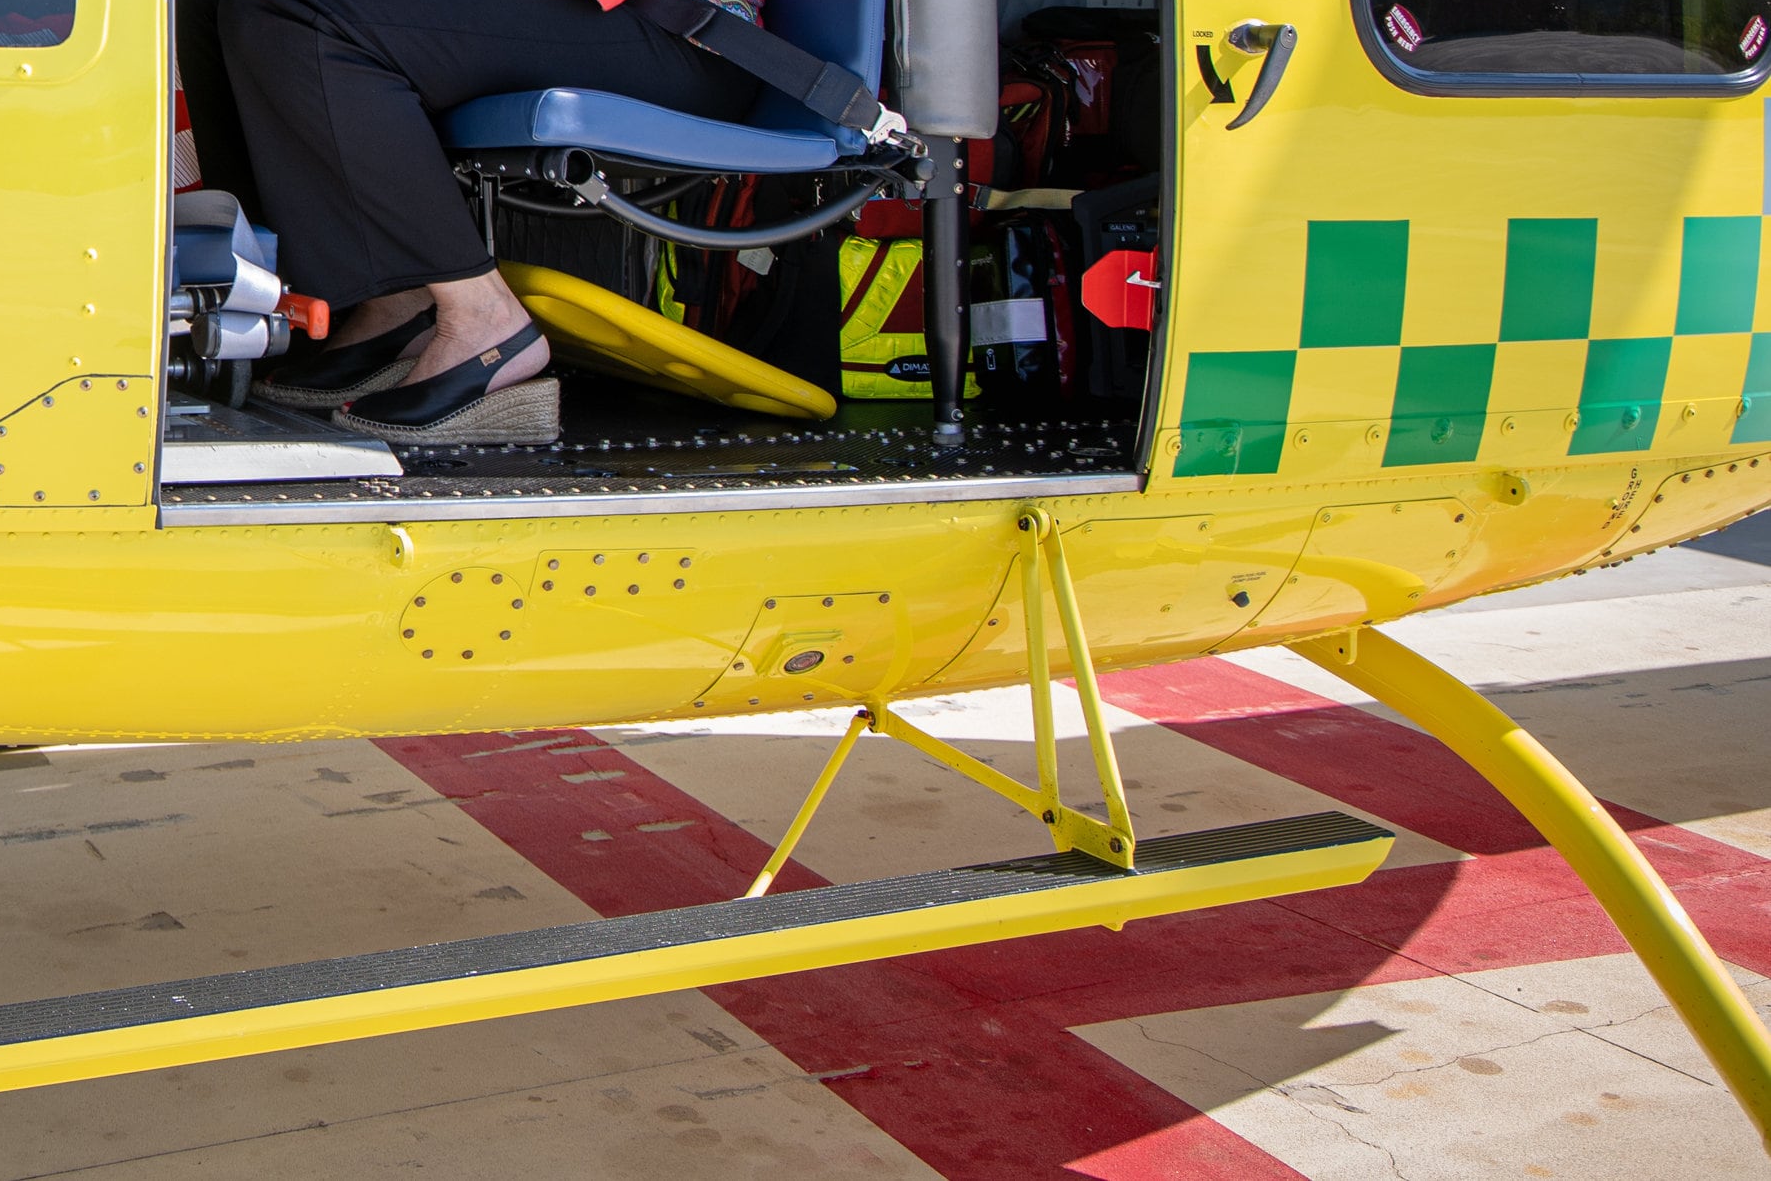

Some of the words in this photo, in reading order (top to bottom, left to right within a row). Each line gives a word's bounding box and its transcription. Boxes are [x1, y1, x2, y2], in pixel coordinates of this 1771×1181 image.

[1192, 30, 1214, 38] LOCKED
[1384, 15, 1399, 37] PUSH
[1396, 36, 1414, 52] HERE
[1390, 5, 1421, 43] EMERGENCY
[1615, 479, 1643, 519] HERE
